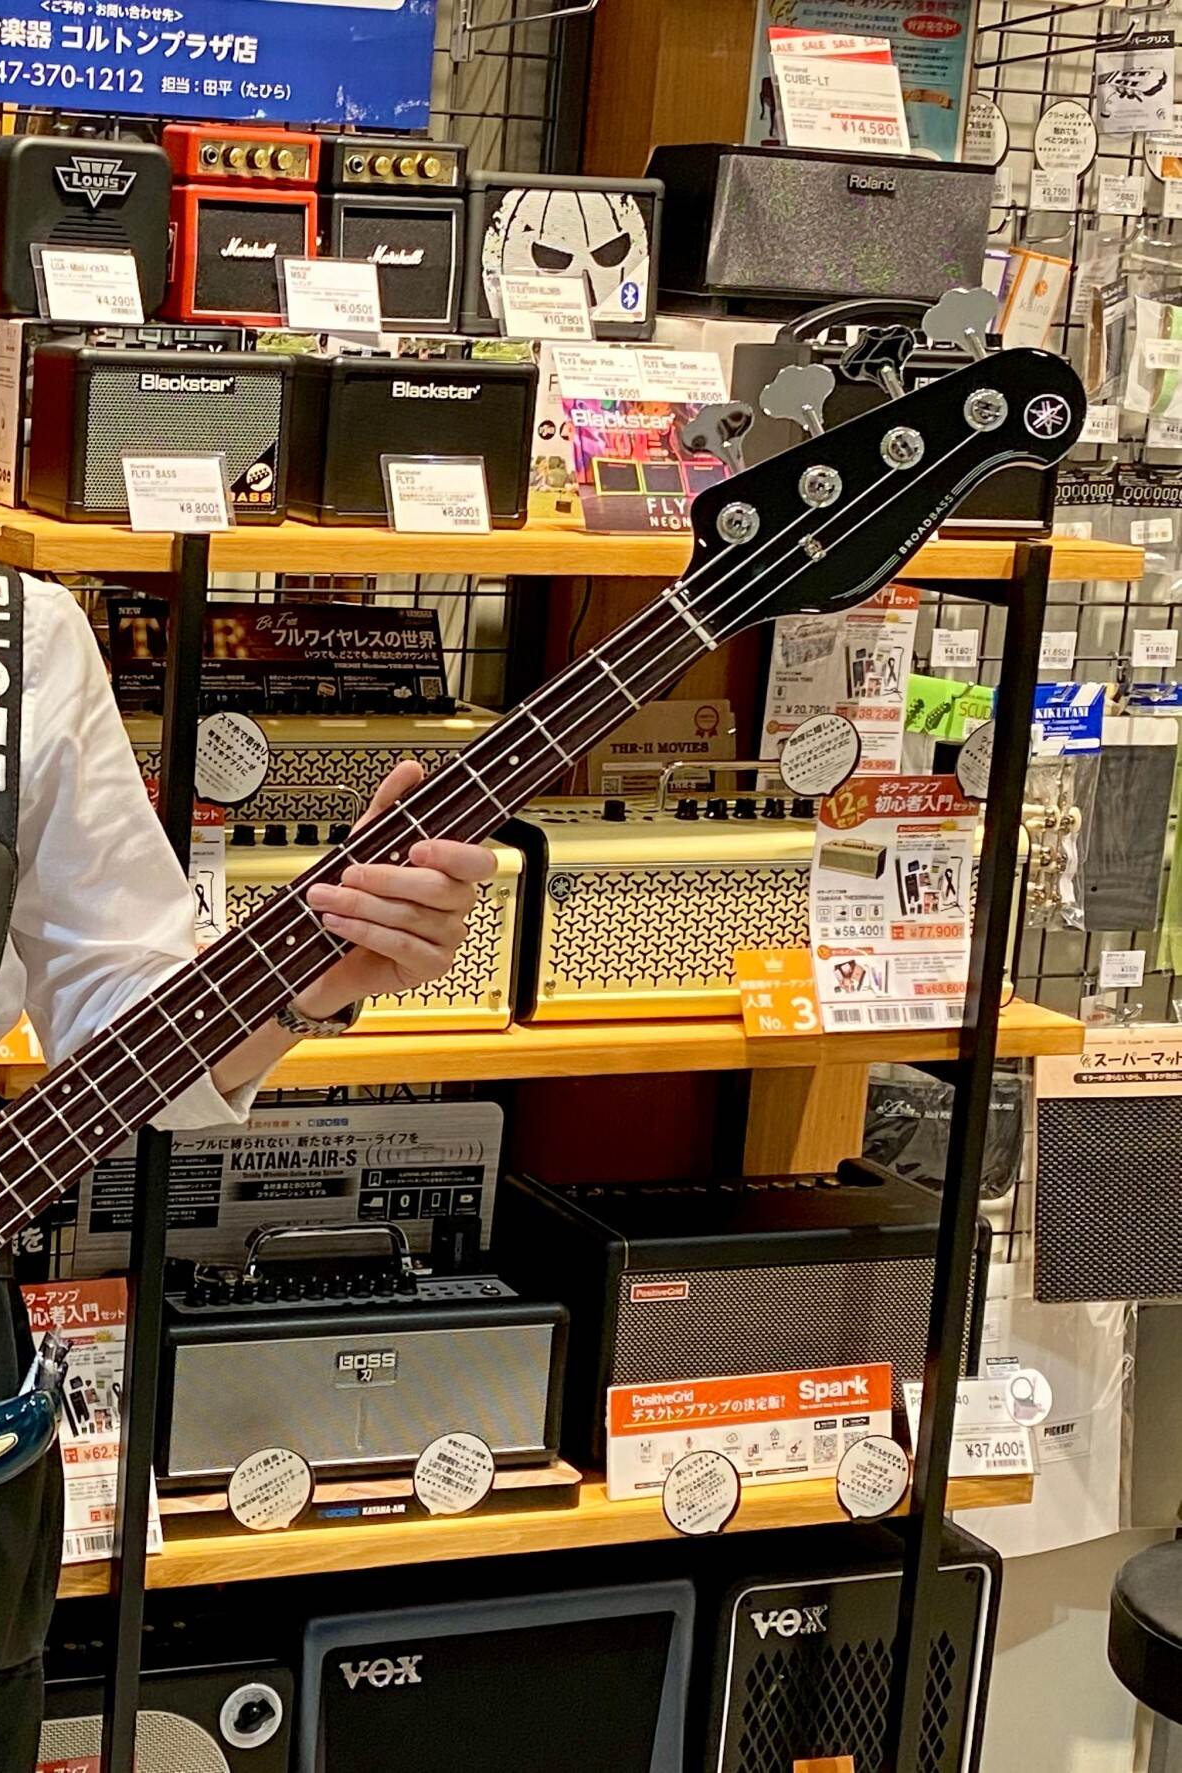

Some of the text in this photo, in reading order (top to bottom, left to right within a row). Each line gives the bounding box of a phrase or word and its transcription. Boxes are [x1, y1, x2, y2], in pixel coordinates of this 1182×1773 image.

[60, 22, 258, 65] コルトンプラザ店
[802, 39, 826, 50] SALE
[833, 38, 856, 49] SALE
[784, 73, 829, 86] CUBE-LT
[72, 172, 120, 190] Louis
[849, 175, 896, 190] Roland
[220, 237, 277, 259] Marshall
[367, 245, 425, 265] Marshall
[141, 373, 234, 392] Blackstar
[392, 381, 480, 399] Blackstar
[571, 409, 674, 429] Blackstar
[156, 469, 177, 479] BASS
[646, 497, 686, 515] FLY
[650, 516, 691, 529] NEON
[899, 494, 955, 555] BROADBASS
[272, 629, 436, 649] フルワイヤレスの世界
[959, 701, 991, 718] SCUD
[1035, 707, 1089, 719] KIKUTANI
[610, 741, 709, 754] THR-II MOVIES
[878, 781, 942, 793] ギターアンプ
[836, 812, 866, 828] セット
[745, 994, 773, 1008] 人気
[759, 997, 818, 1031] No. 3
[230, 1150, 357, 1170] KATANA-AIR-S
[636, 1286, 684, 1298] PositiveGrid
[339, 1352, 396, 1370] BOSS
[360, 1368, 373, 1383] 刀
[632, 1376, 869, 1407] PositiveGrid Spark
[631, 1396, 786, 1423] デスクトップアンプの決定版！
[966, 1442, 1018, 1458] ¥37,400
[362, 1504, 406, 1515] KATANA-AIR
[751, 1605, 828, 1640] VOX
[340, 1654, 423, 1690] VOX
